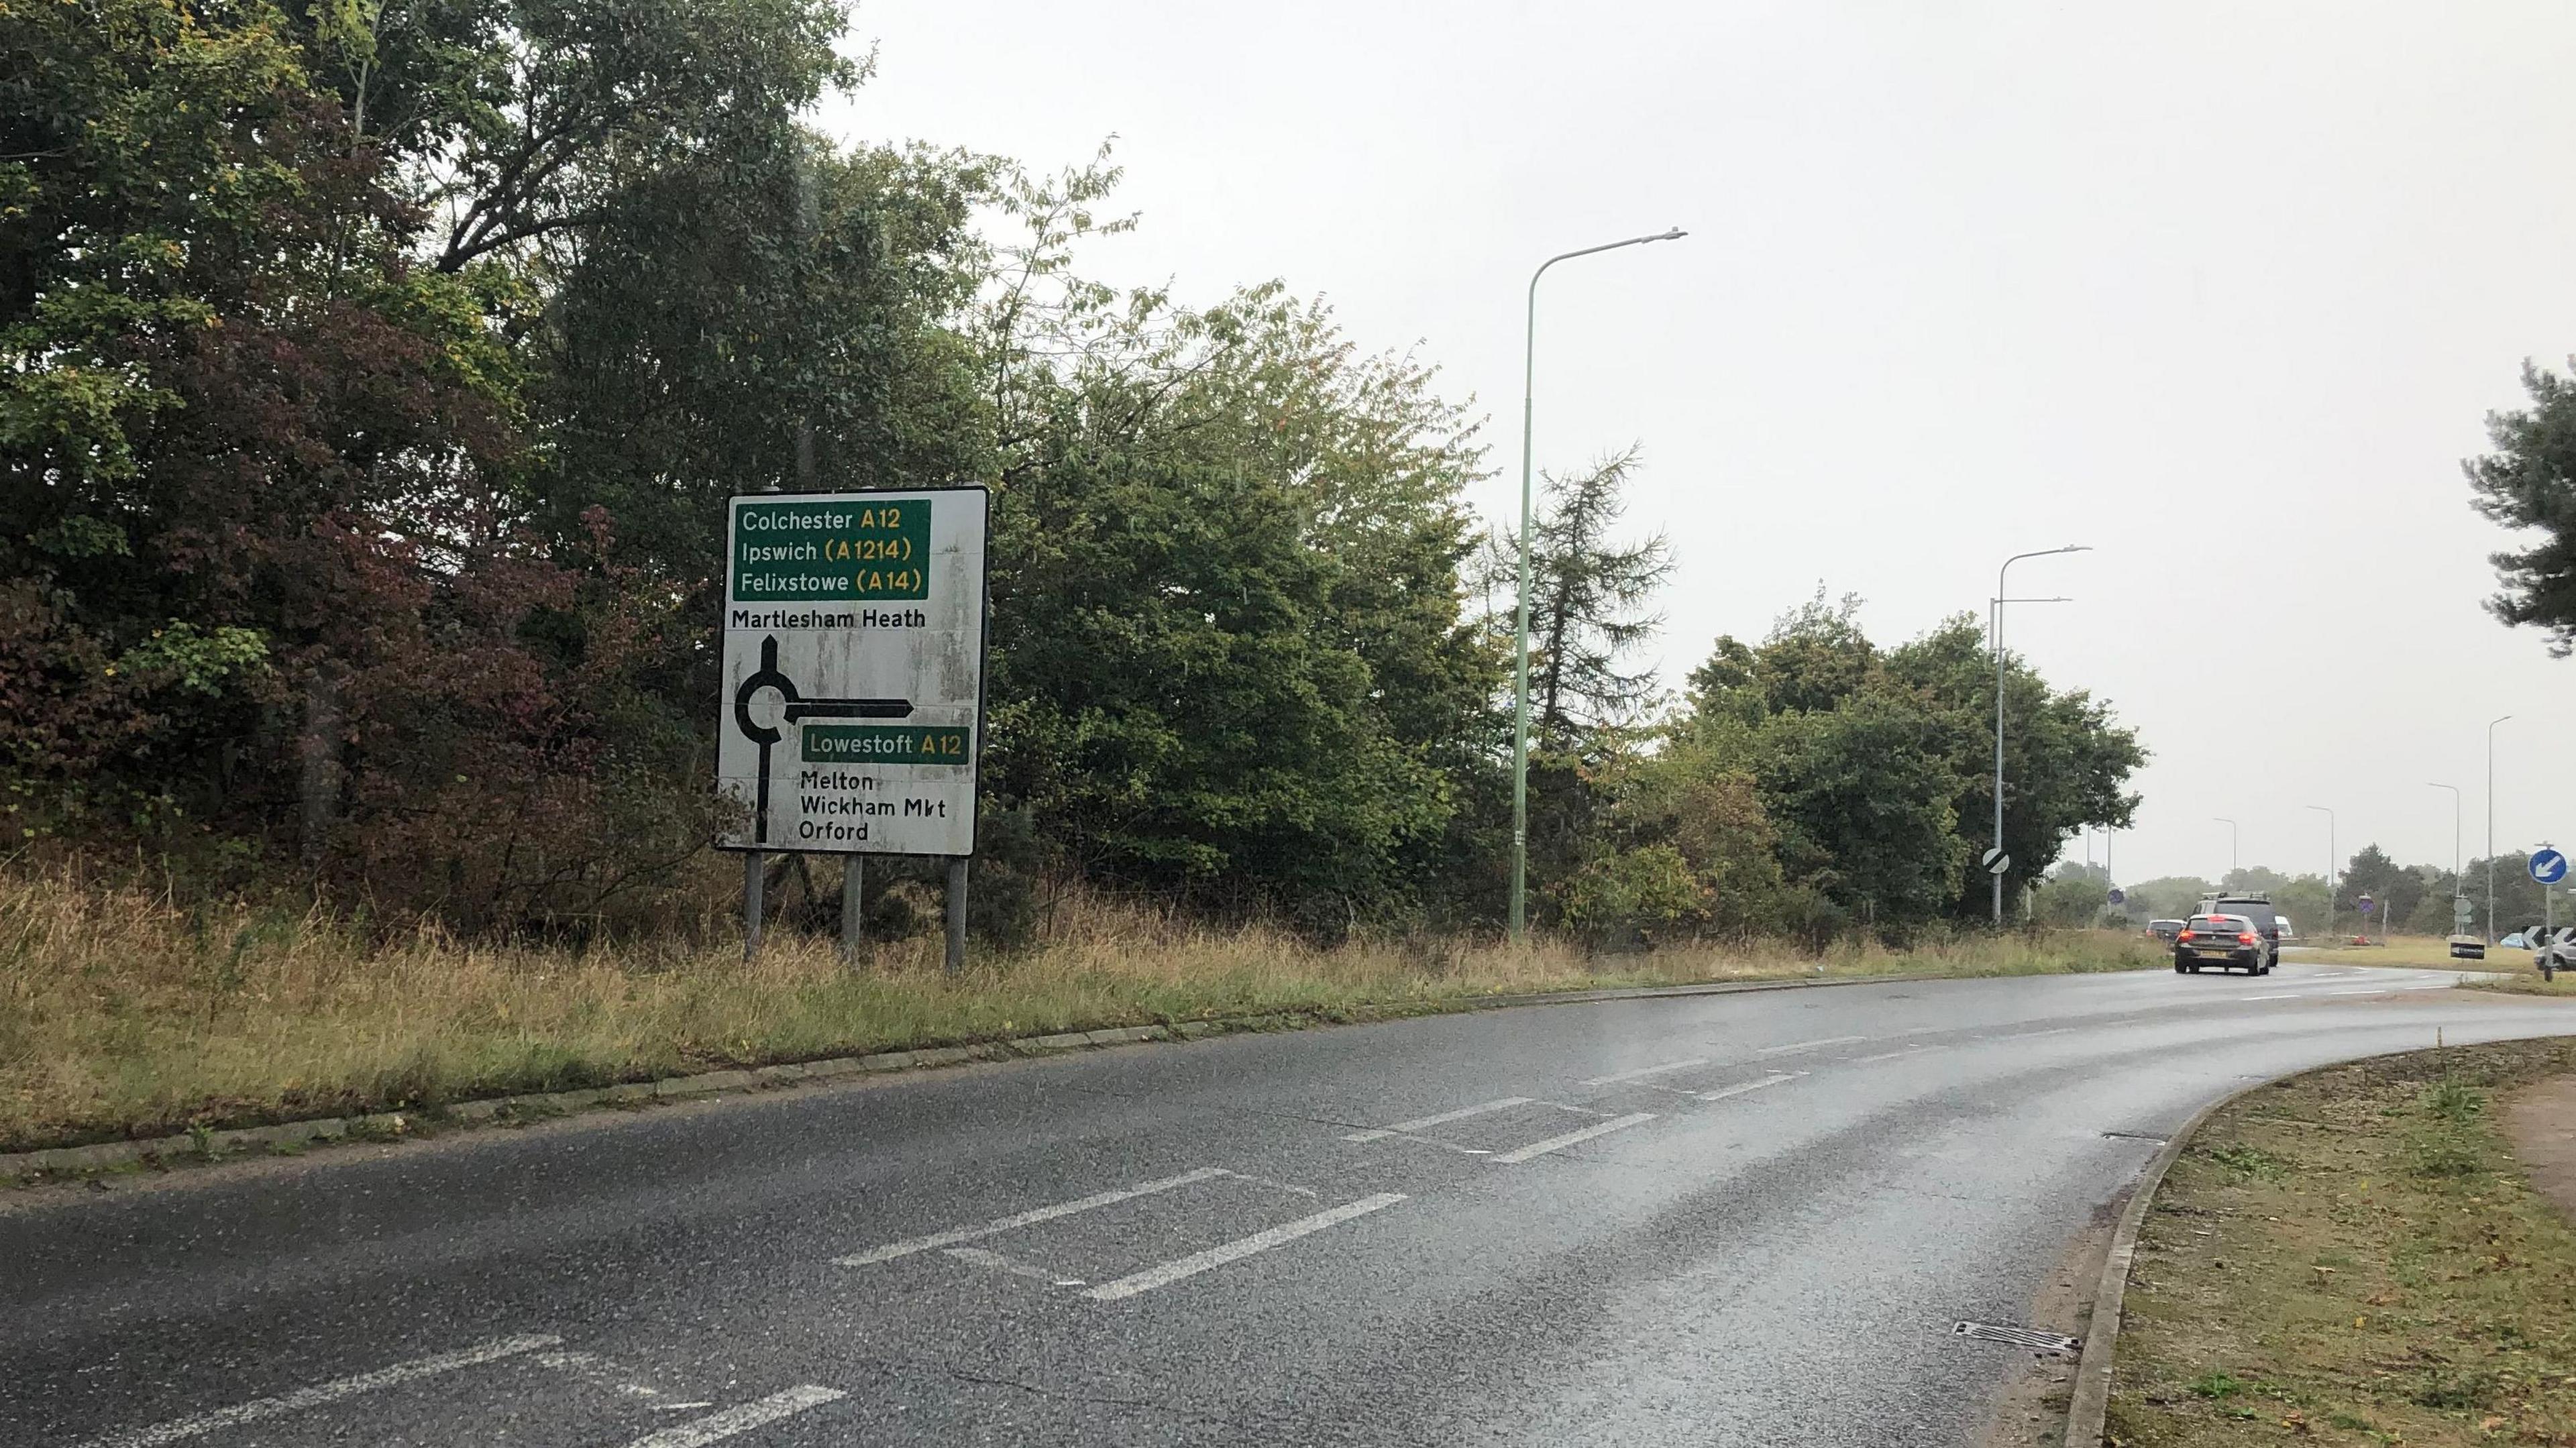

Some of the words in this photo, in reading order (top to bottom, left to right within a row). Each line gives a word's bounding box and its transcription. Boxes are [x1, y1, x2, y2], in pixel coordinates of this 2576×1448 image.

[743, 510, 853, 531] Colchester
[861, 508, 901, 528] A12
[743, 541, 817, 565] Ipswich
[825, 537, 911, 562] (A1214)
[741, 573, 849, 592] Felixstowe
[857, 569, 921, 593] (A14)
[733, 610, 854, 628] Martlesham
[863, 609, 926, 628] Heath
[810, 733, 913, 754] Lowestoft
[921, 734, 961, 755] A12
[800, 771, 873, 791] Melton
[800, 795, 895, 816] Wickham
[904, 798, 946, 818] Mkt
[799, 820, 868, 840] Orford
